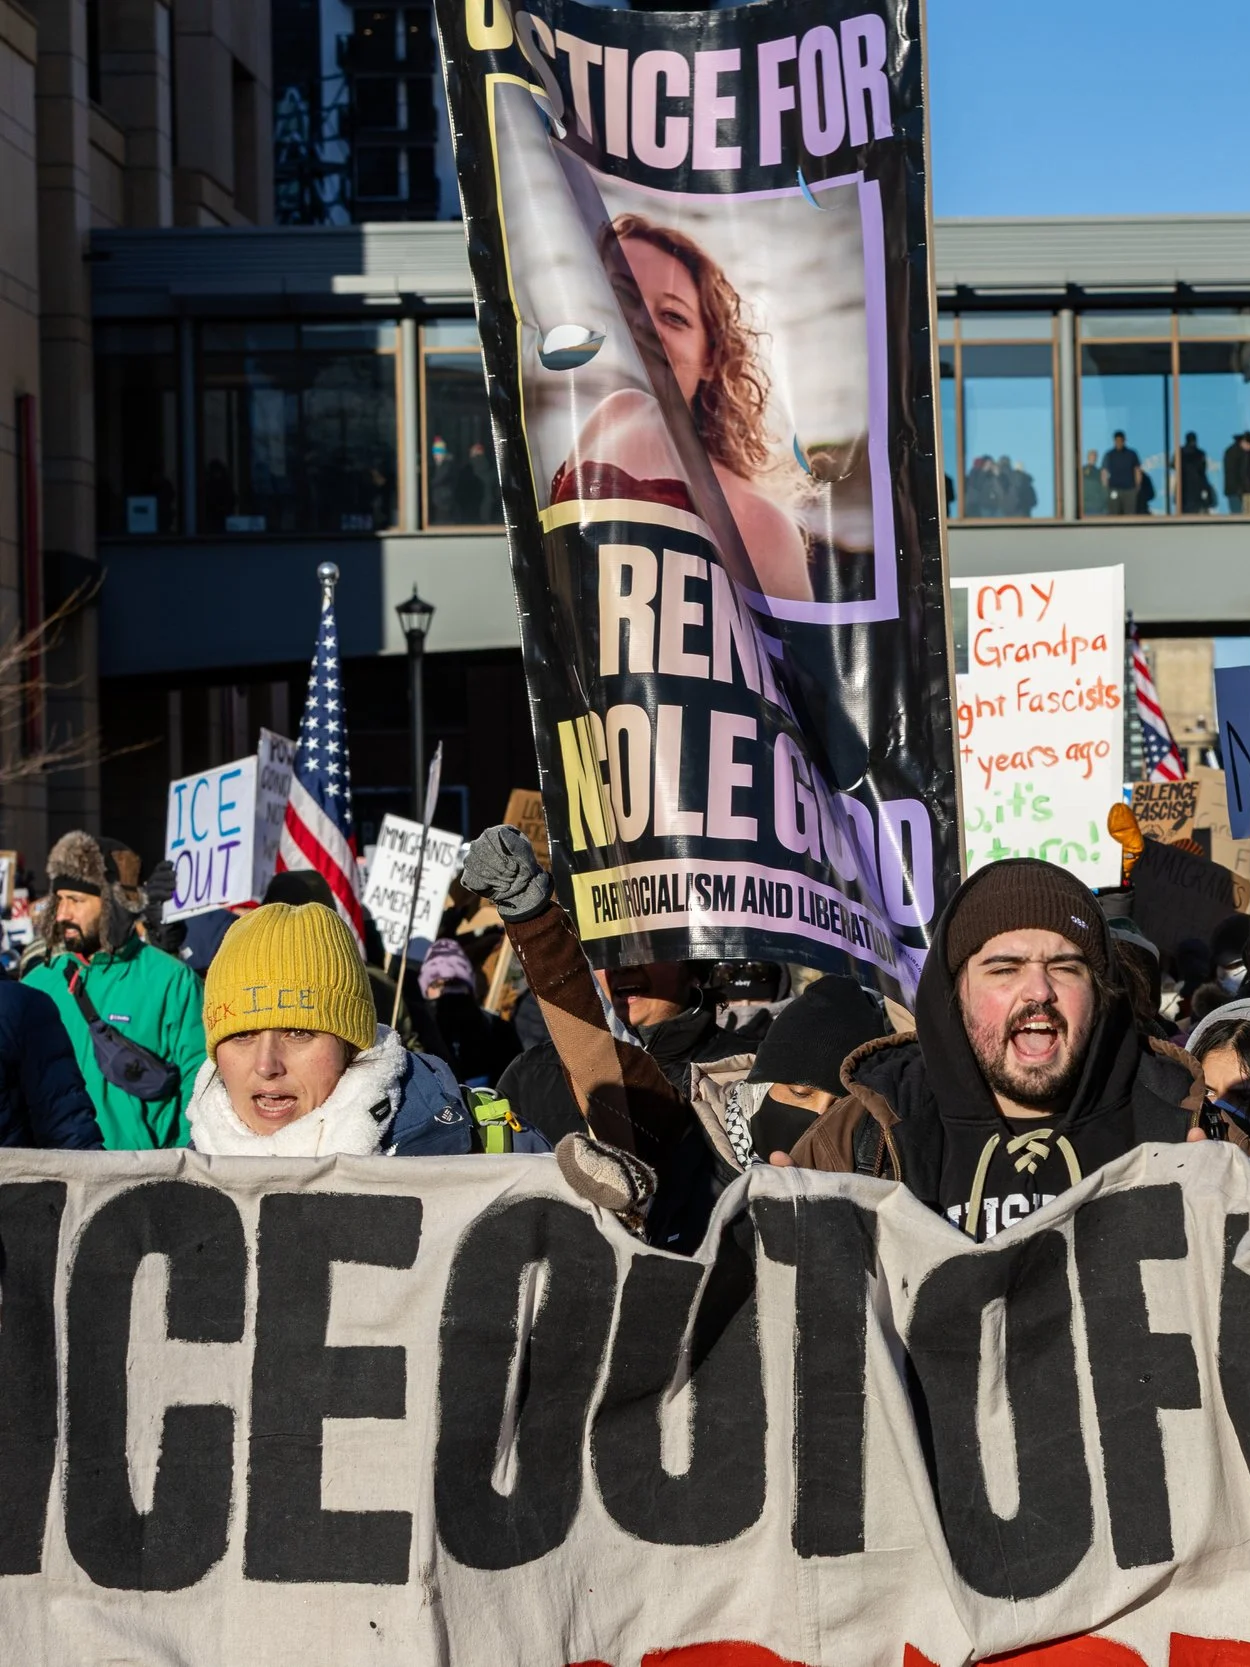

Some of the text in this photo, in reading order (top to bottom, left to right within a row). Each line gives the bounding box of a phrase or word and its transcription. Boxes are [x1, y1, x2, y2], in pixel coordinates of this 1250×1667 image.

[466, 0, 893, 171] STICE FOR
[598, 544, 795, 727] REN
[973, 622, 1108, 668] Grandpa
[956, 675, 1122, 739] ght Fascists
[558, 703, 758, 852] NOLE
[977, 744, 1060, 791] years
[1065, 739, 1111, 781] ago
[171, 768, 242, 850] ICE
[1132, 800, 1197, 822] FASCISM
[1134, 781, 1200, 802] SILENCE
[381, 826, 456, 867] MMIGANTS
[984, 820, 1100, 864] trn!
[172, 840, 241, 909] OUT
[389, 861, 431, 891] MAE
[591, 881, 621, 923] PAR
[631, 872, 736, 918] OCIALISM
[741, 876, 794, 919] AND
[1138, 843, 1246, 909] MMIGRANTS
[370, 885, 431, 922] AMERCA
[242, 985, 316, 1014] ICE
[0, 1180, 423, 1592] ICE
[433, 1194, 878, 1571] OUT
[904, 1182, 1203, 1602] OF
